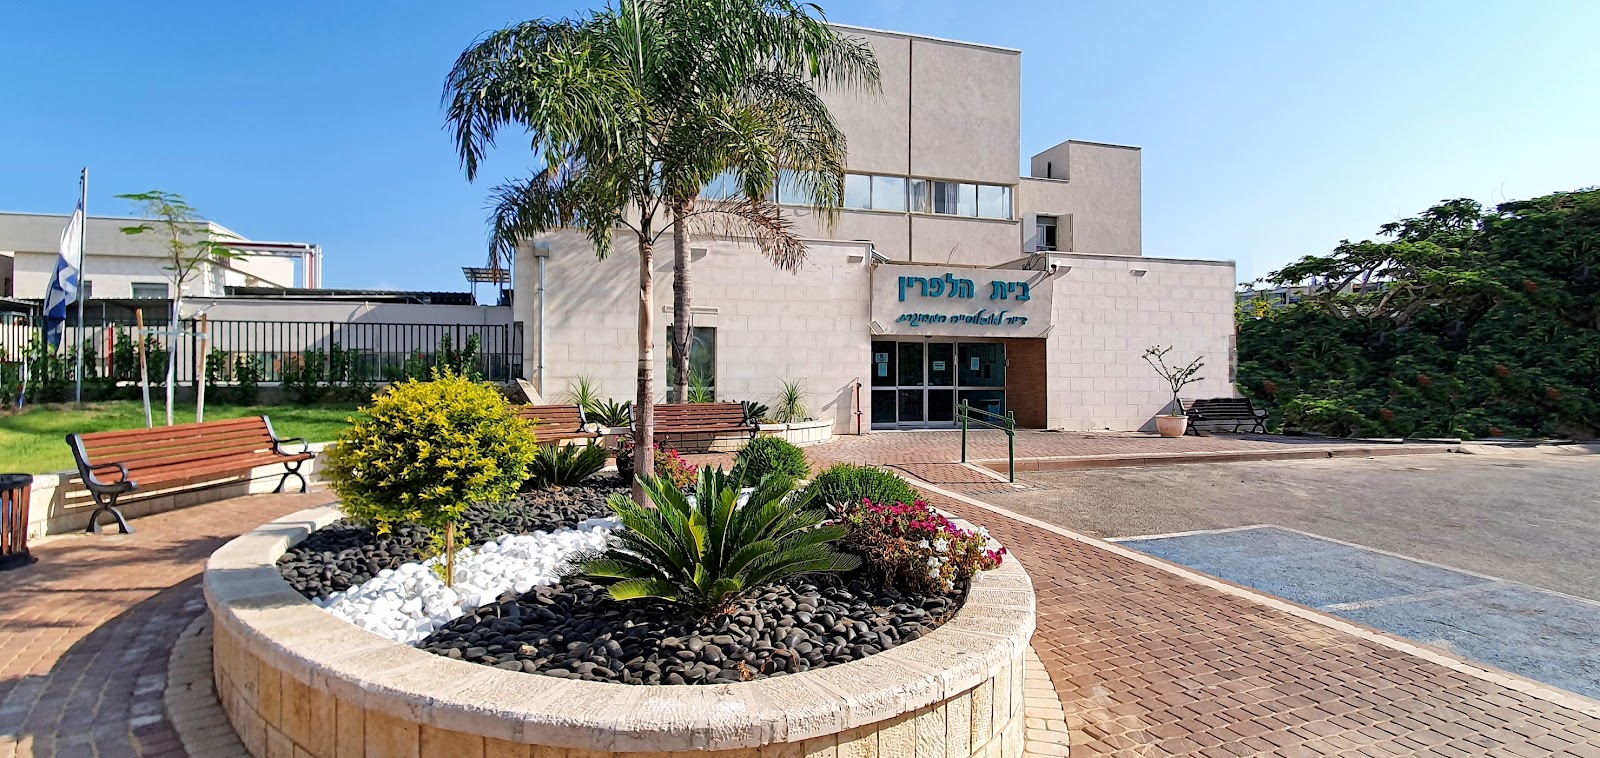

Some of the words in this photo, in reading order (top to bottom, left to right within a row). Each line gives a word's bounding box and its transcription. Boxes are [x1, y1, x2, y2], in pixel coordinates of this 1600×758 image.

[898, 272, 975, 302] הלפרין
[990, 280, 1030, 301] בית
[1006, 315, 1028, 325] דיור
